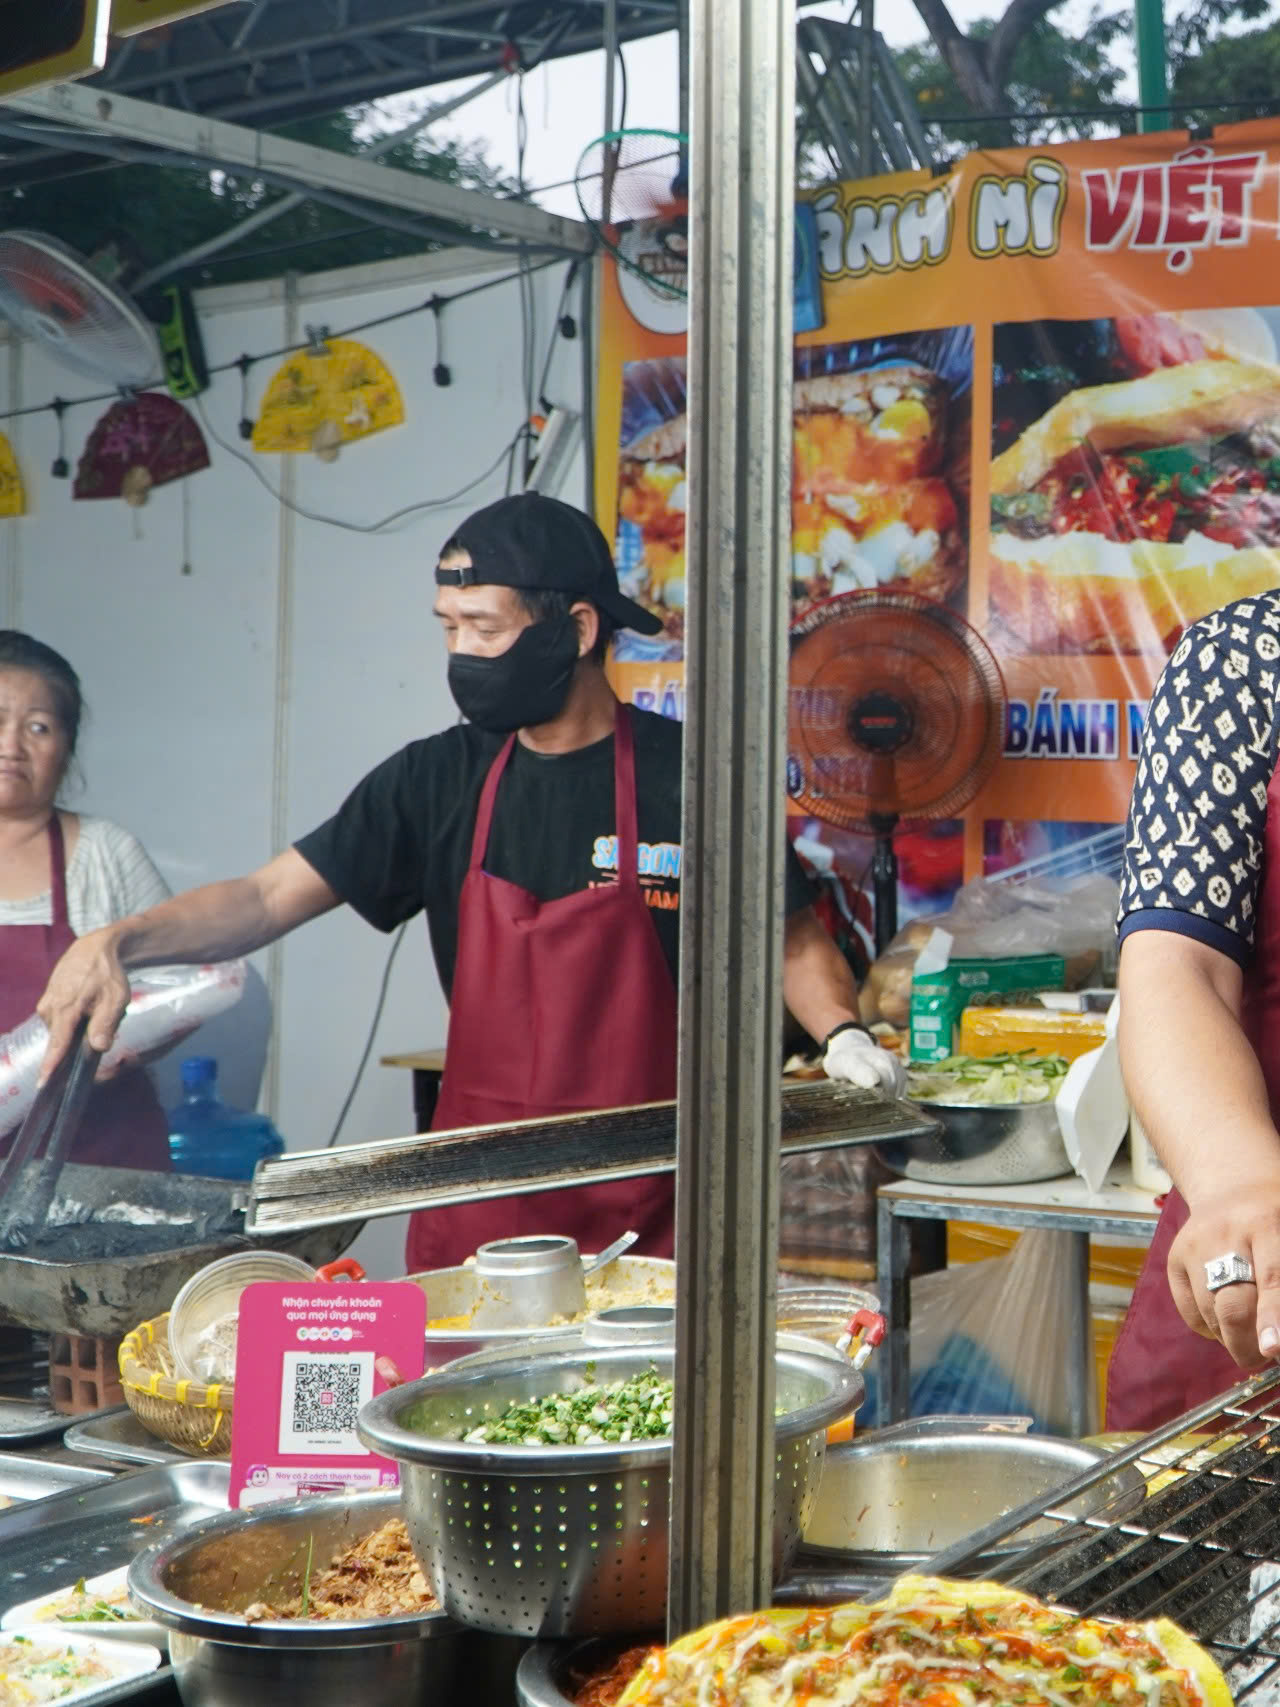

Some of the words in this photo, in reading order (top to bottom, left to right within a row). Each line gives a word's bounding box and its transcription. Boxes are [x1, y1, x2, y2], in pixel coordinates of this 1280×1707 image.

[815, 187, 955, 280] ÁNH
[968, 156, 1068, 259] MÌ
[1082, 144, 1267, 274] VIỆT
[1002, 686, 1118, 759] BÁNH
[282, 1297, 309, 1309] Nhận
[311, 1296, 348, 1309] chuyển
[286, 1311, 307, 1321] qua
[308, 1309, 328, 1322] mọi
[350, 1311, 377, 1322] dụng
